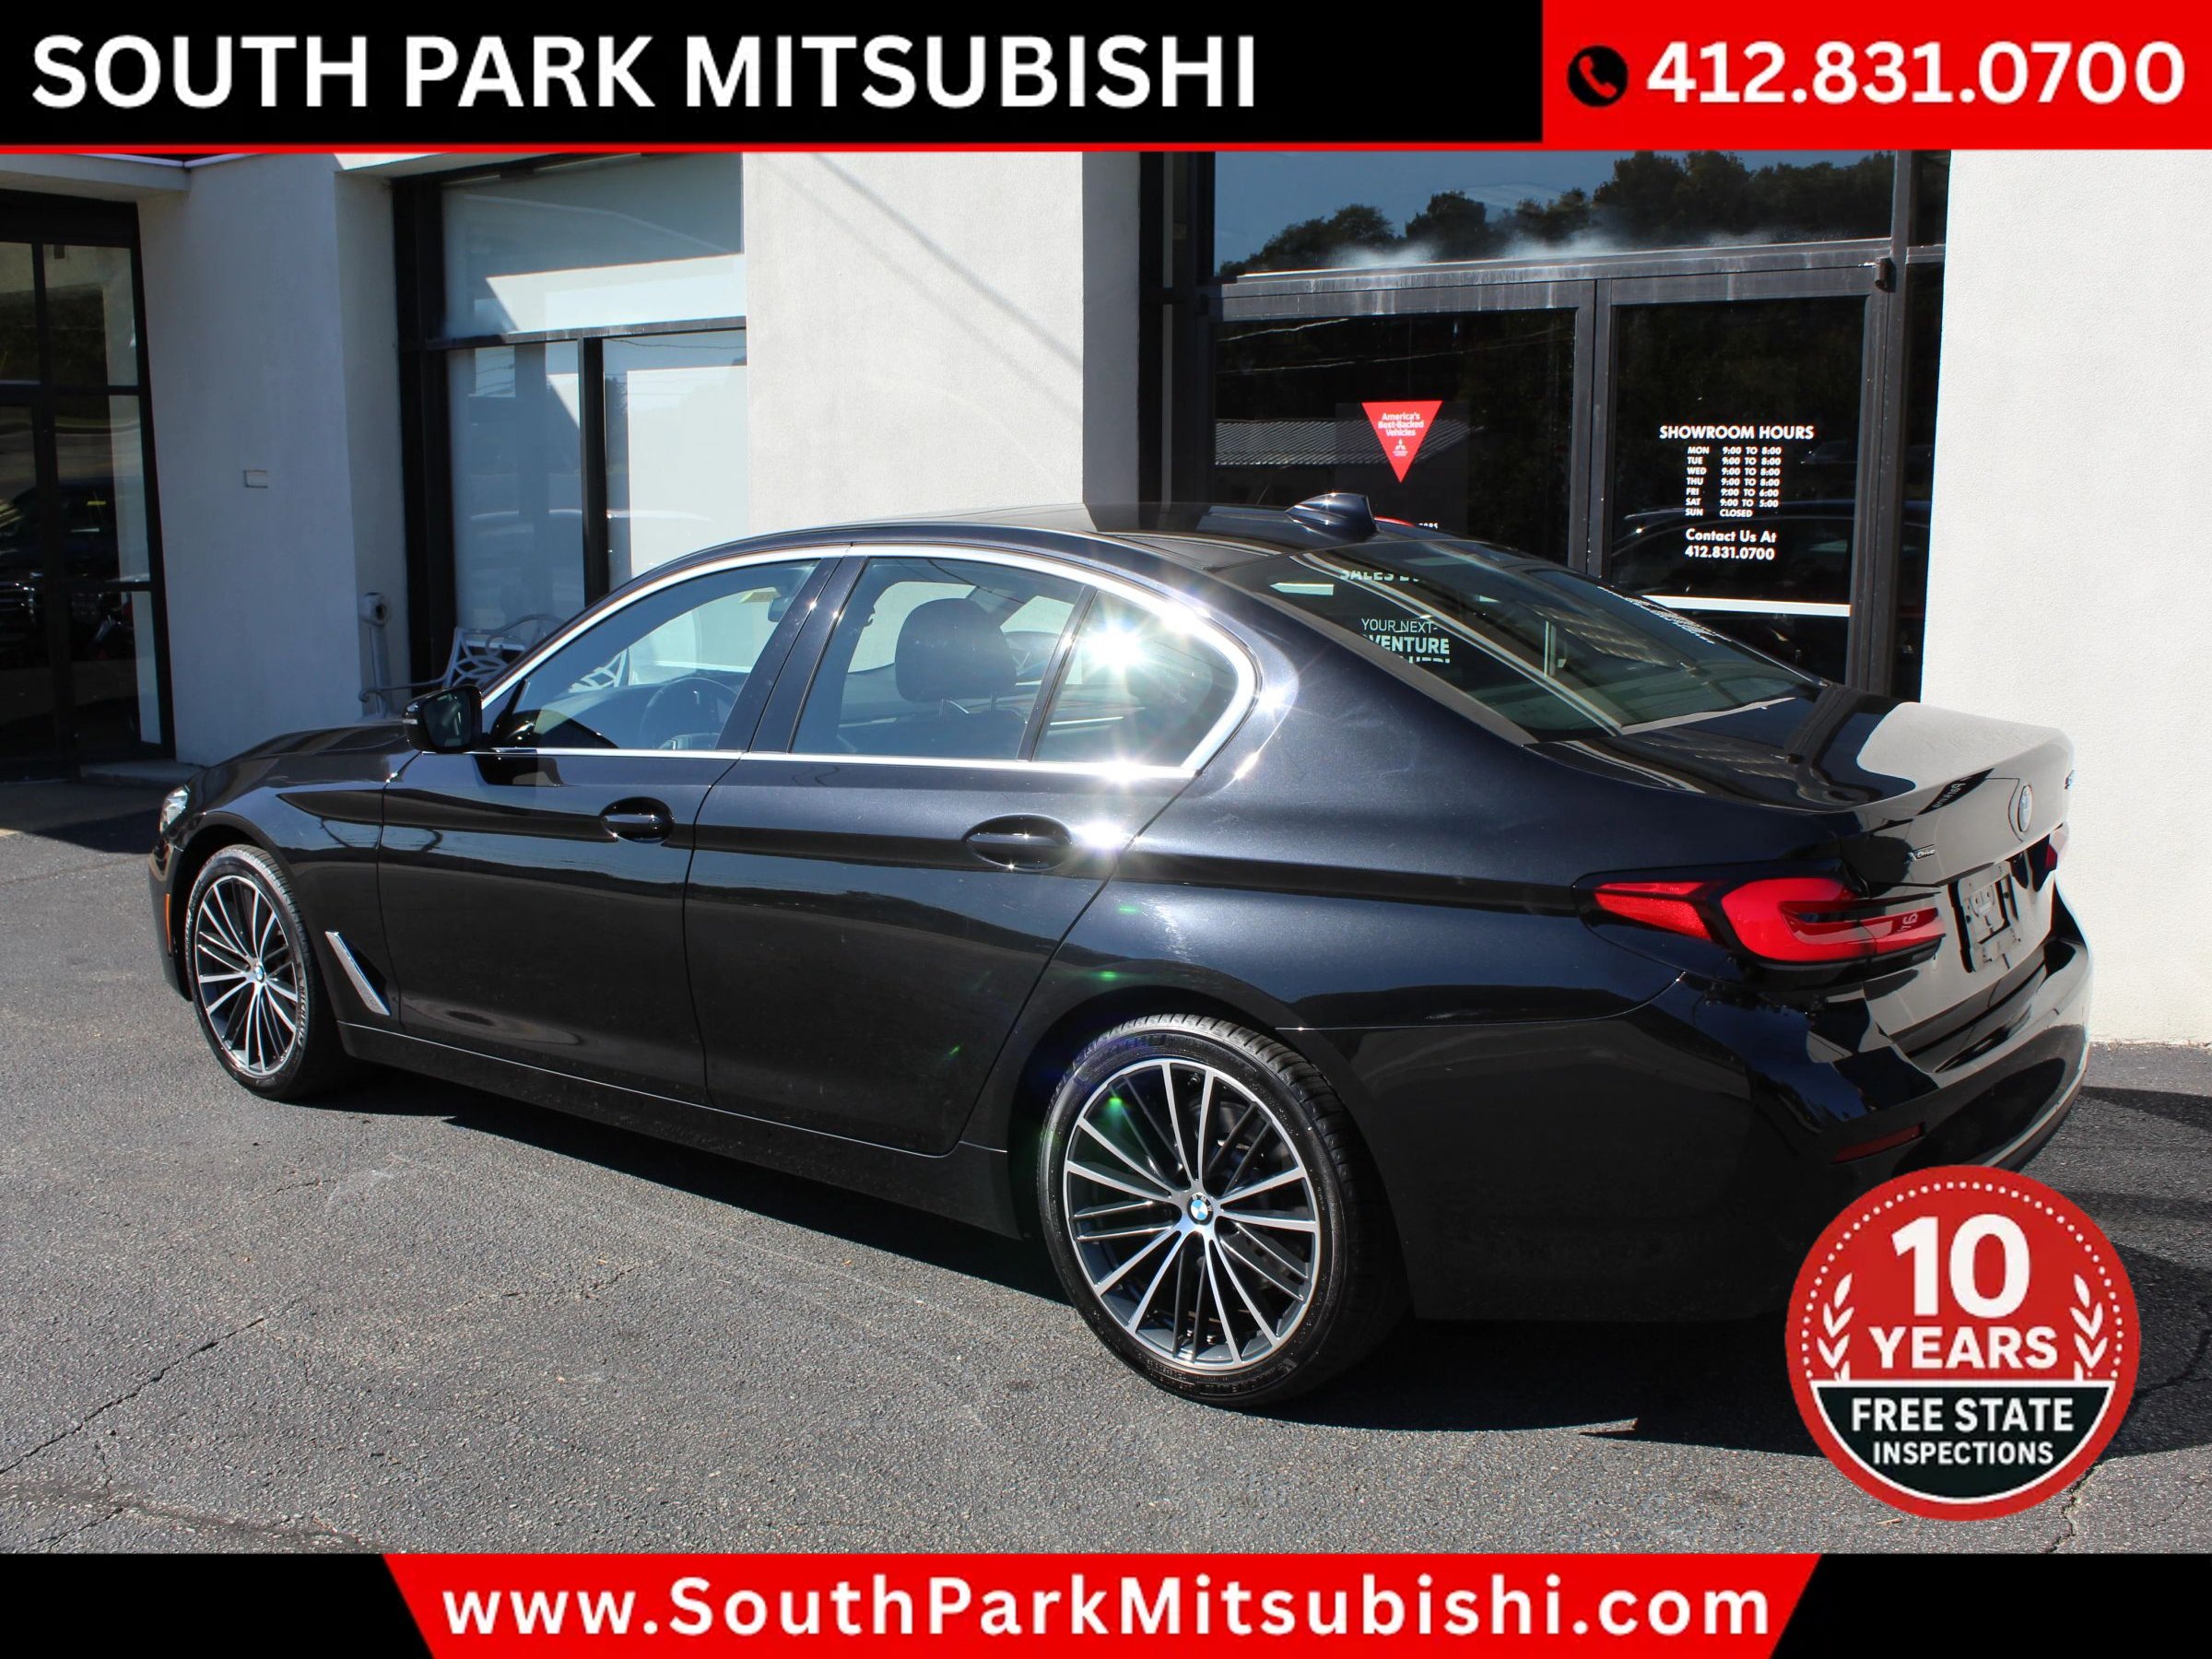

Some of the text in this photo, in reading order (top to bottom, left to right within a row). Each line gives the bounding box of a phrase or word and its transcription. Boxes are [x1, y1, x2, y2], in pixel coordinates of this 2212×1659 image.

[1382, 412, 1420, 421] America's
[1385, 429, 1417, 437] Vehicles
[1659, 425, 1815, 440] SHOWROOM HOURS
[1688, 446, 1782, 455] MON 9:00 TO 8:00
[1688, 456, 1781, 466] TUE 9:00 TO 8:00
[1687, 467, 1781, 477] WED 9:00 TO 8:00
[1687, 477, 1780, 487] THU 9:00 TO 8:00
[1686, 488, 1779, 498] FRI 9:00 TO 6:00
[1686, 498, 1779, 508] SAT 9:00 TO 5:00
[1685, 508, 1753, 518] SUN CLOSED
[1686, 527, 1777, 543] Contact Us At
[1685, 545, 1775, 560] 412.831.0700
[1361, 618, 1432, 634] YOUR NEXT
[1363, 634, 1450, 654] VENTURE
